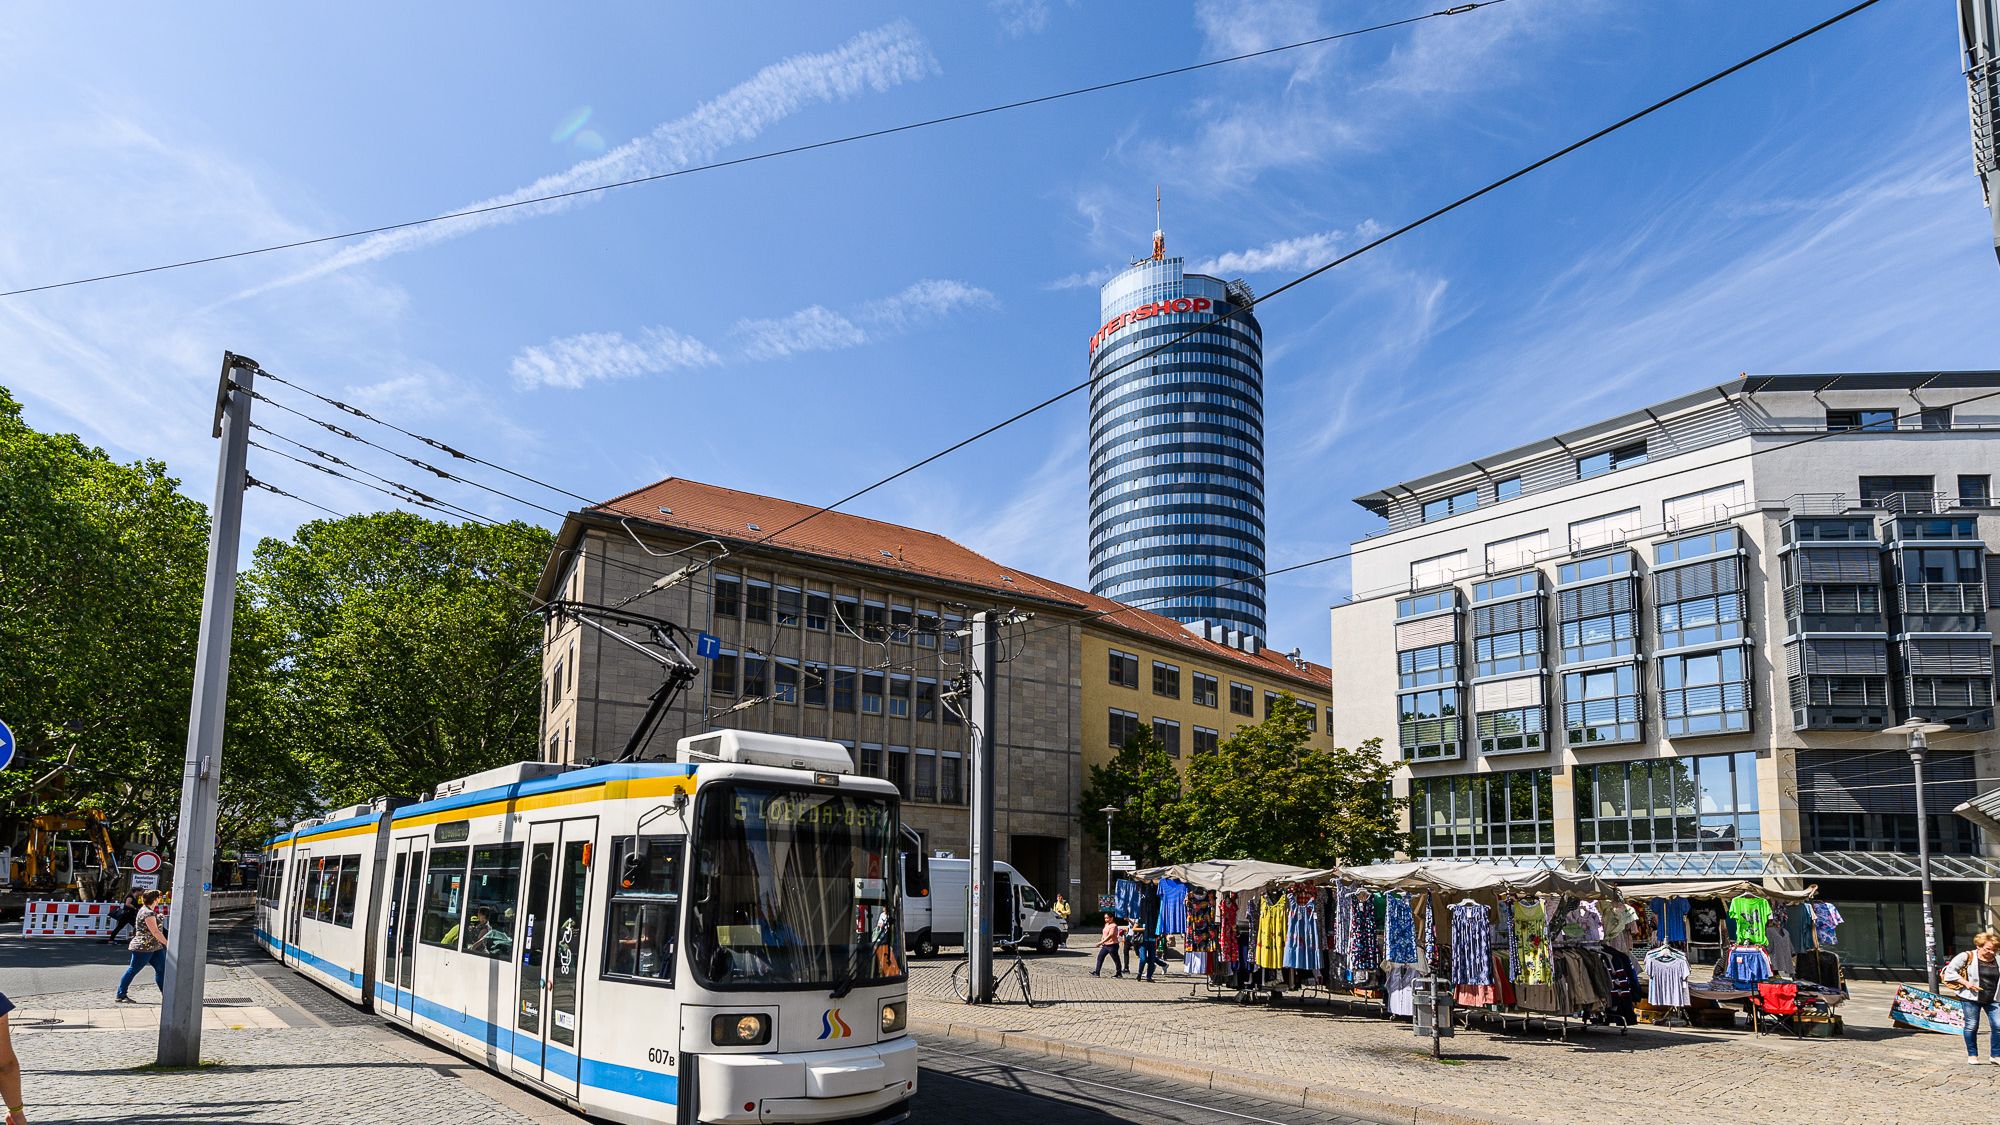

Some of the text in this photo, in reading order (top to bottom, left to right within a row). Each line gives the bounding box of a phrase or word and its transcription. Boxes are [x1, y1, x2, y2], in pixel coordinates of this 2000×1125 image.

[1089, 297, 1211, 353] INTERSHOP
[703, 637, 716, 655] T
[734, 796, 879, 827] 5 LOBEDA-OST
